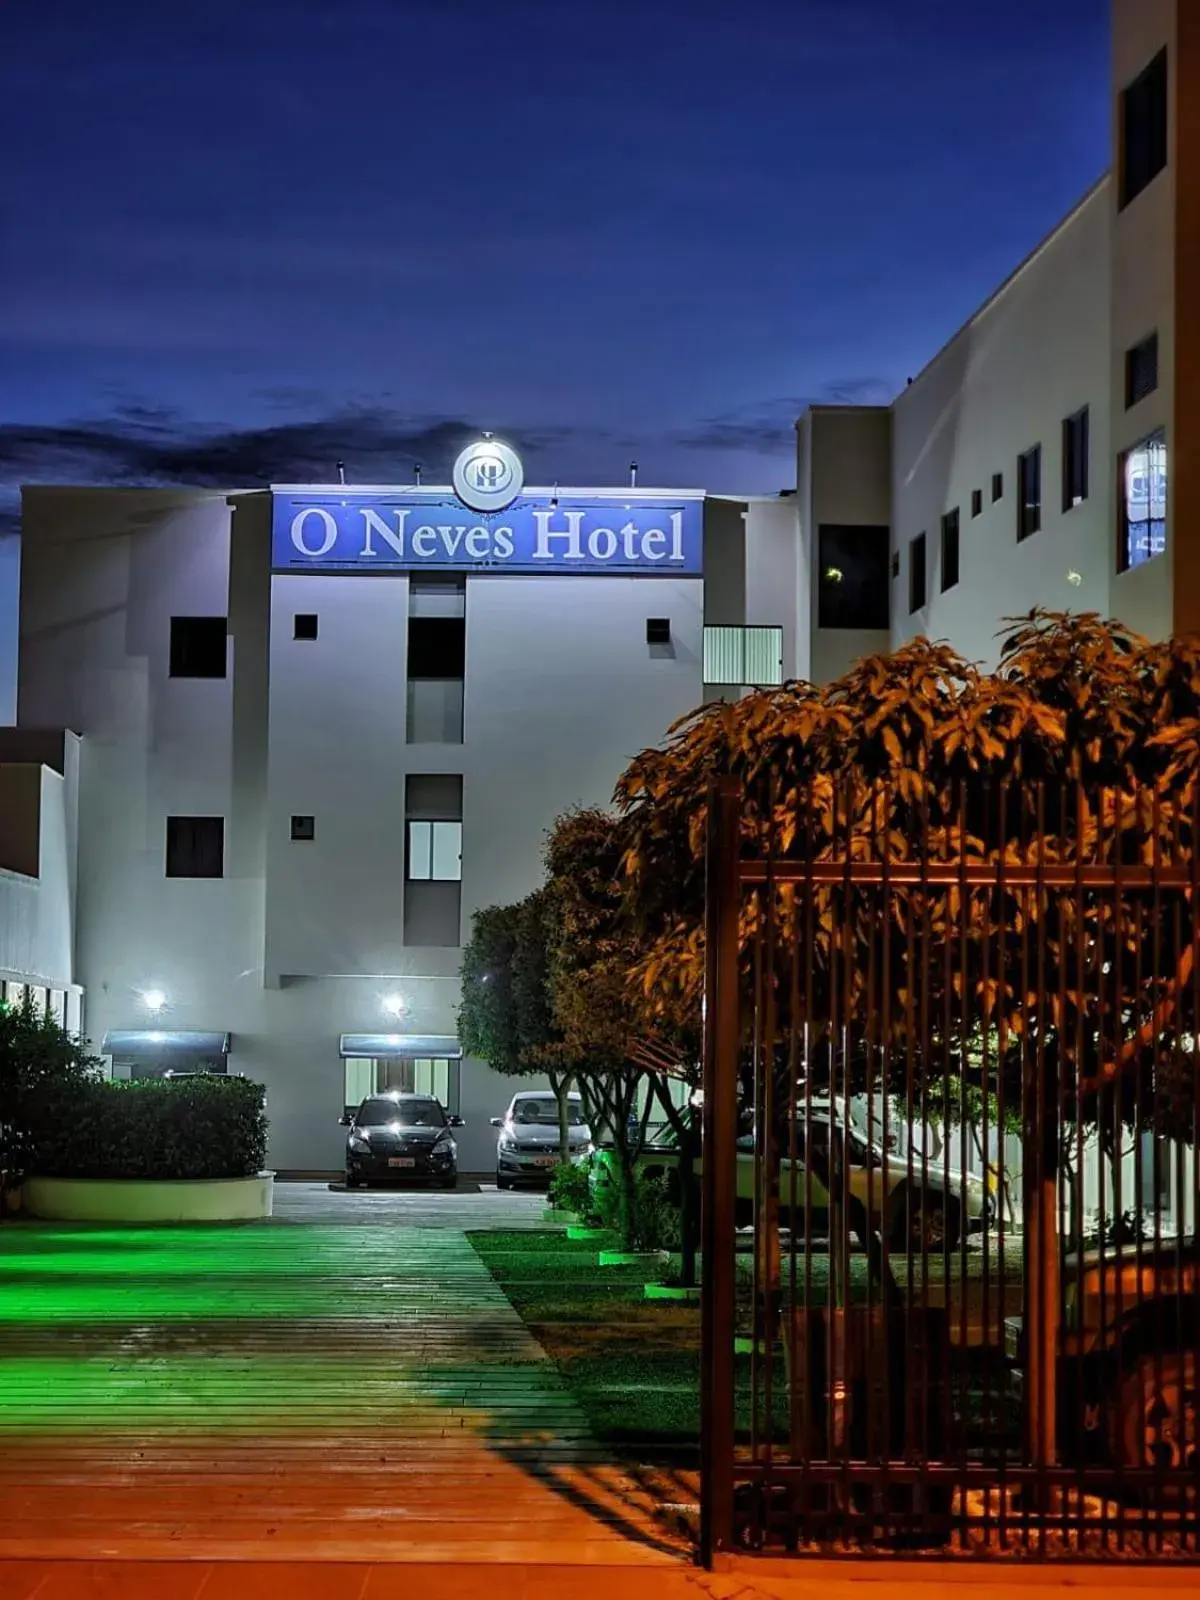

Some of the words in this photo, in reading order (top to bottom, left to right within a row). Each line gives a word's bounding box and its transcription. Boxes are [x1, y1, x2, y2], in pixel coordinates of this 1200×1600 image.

[290, 507, 338, 556] O
[359, 508, 514, 558] Neves
[532, 511, 685, 560] Hotel
